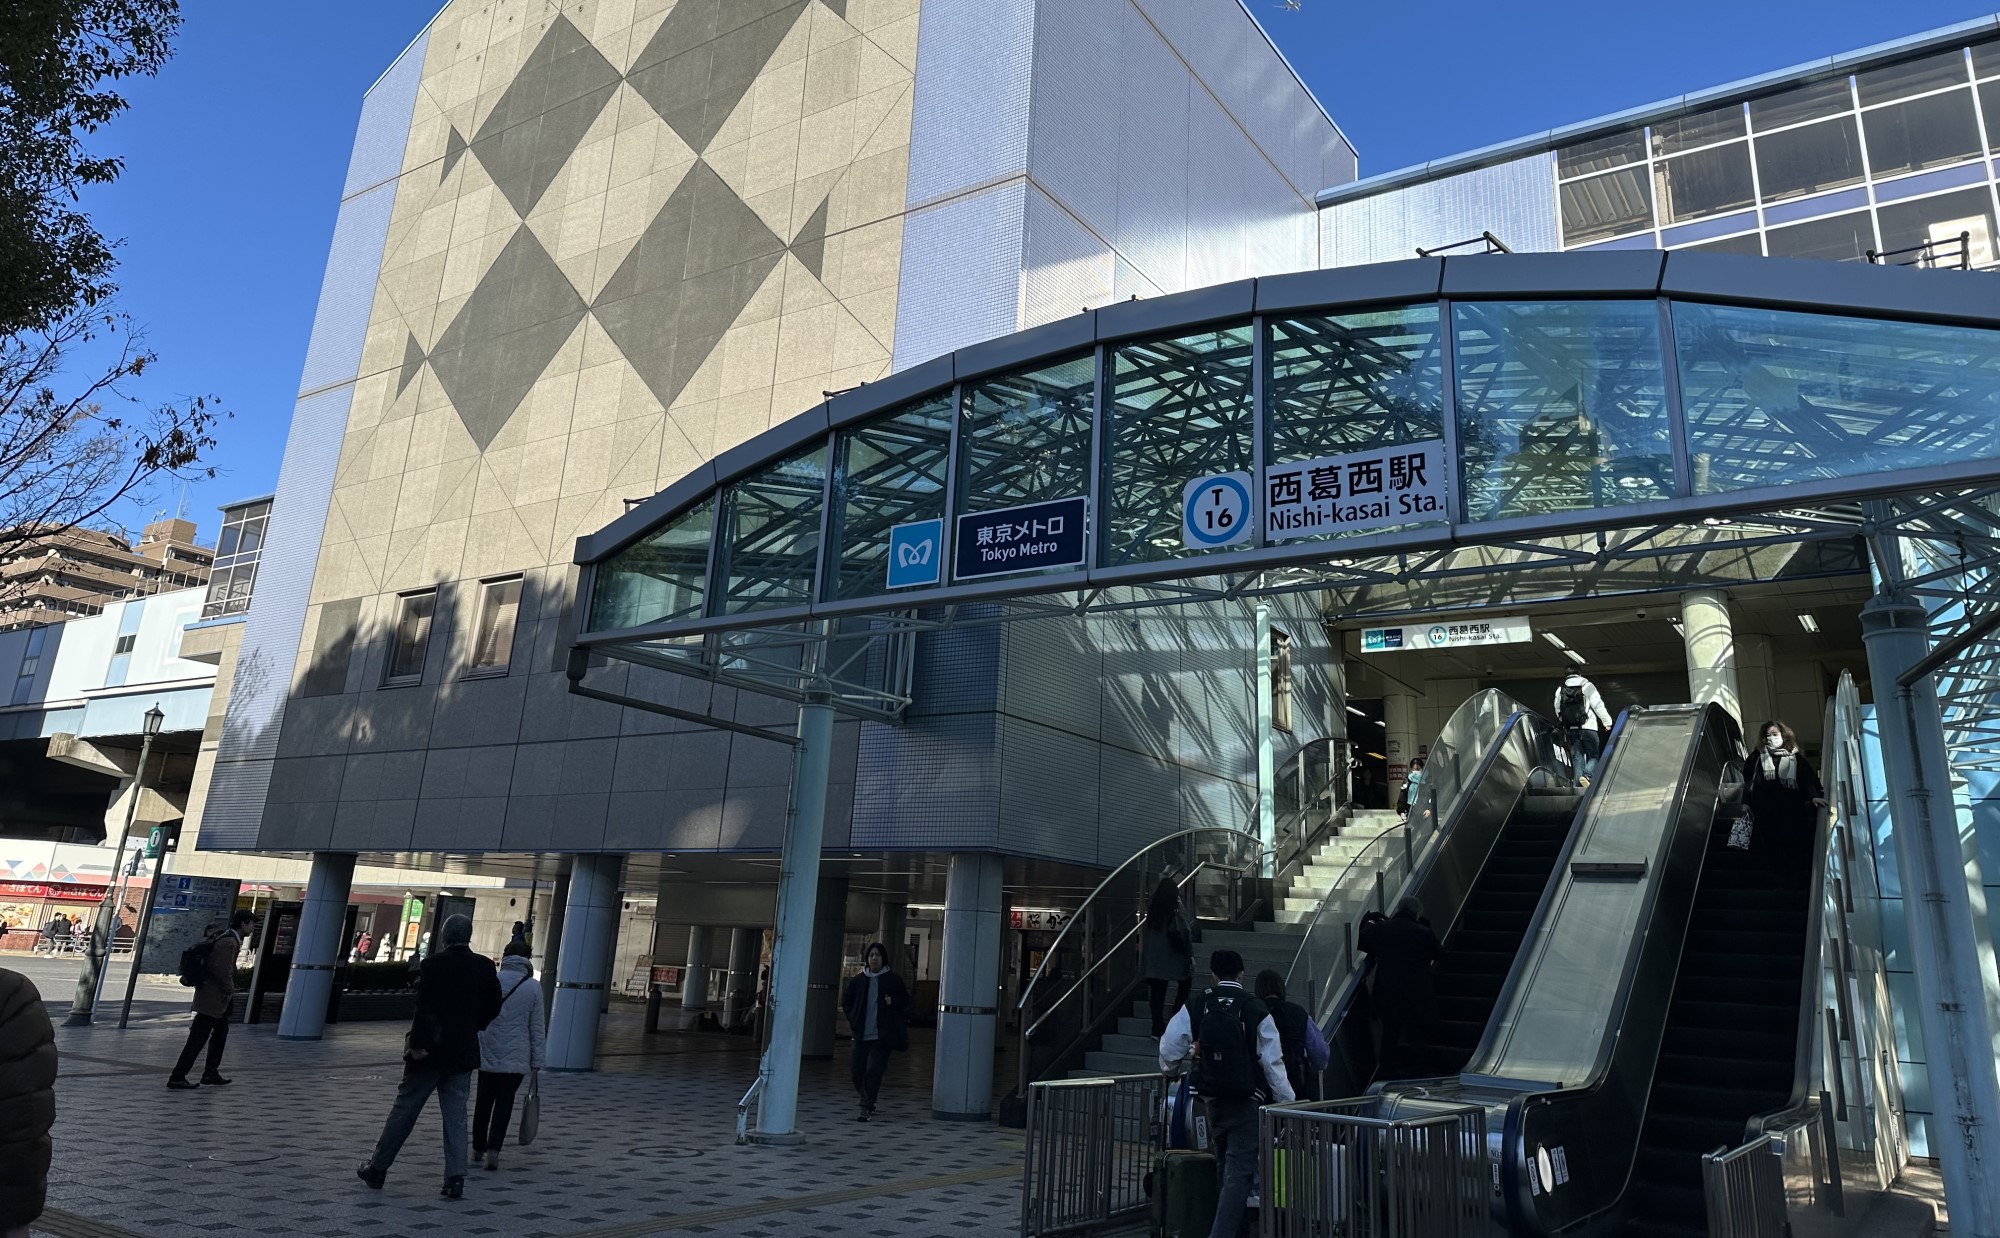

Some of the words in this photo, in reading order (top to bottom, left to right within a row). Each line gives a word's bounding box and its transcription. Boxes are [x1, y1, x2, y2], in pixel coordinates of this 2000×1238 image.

[1269, 452, 1428, 508] 西葛西駅
[1211, 488, 1224, 506] T
[1205, 508, 1233, 529] 16
[1269, 496, 1390, 531] Nishi-kasai
[1399, 493, 1444, 516] Sta.
[976, 516, 1064, 546] 東京メトロ
[981, 547, 1017, 562] Tokyo
[1019, 541, 1058, 557] Metro
[1448, 623, 1490, 636] 西葛西駅
[1448, 633, 1487, 642] Nishi-kasai
